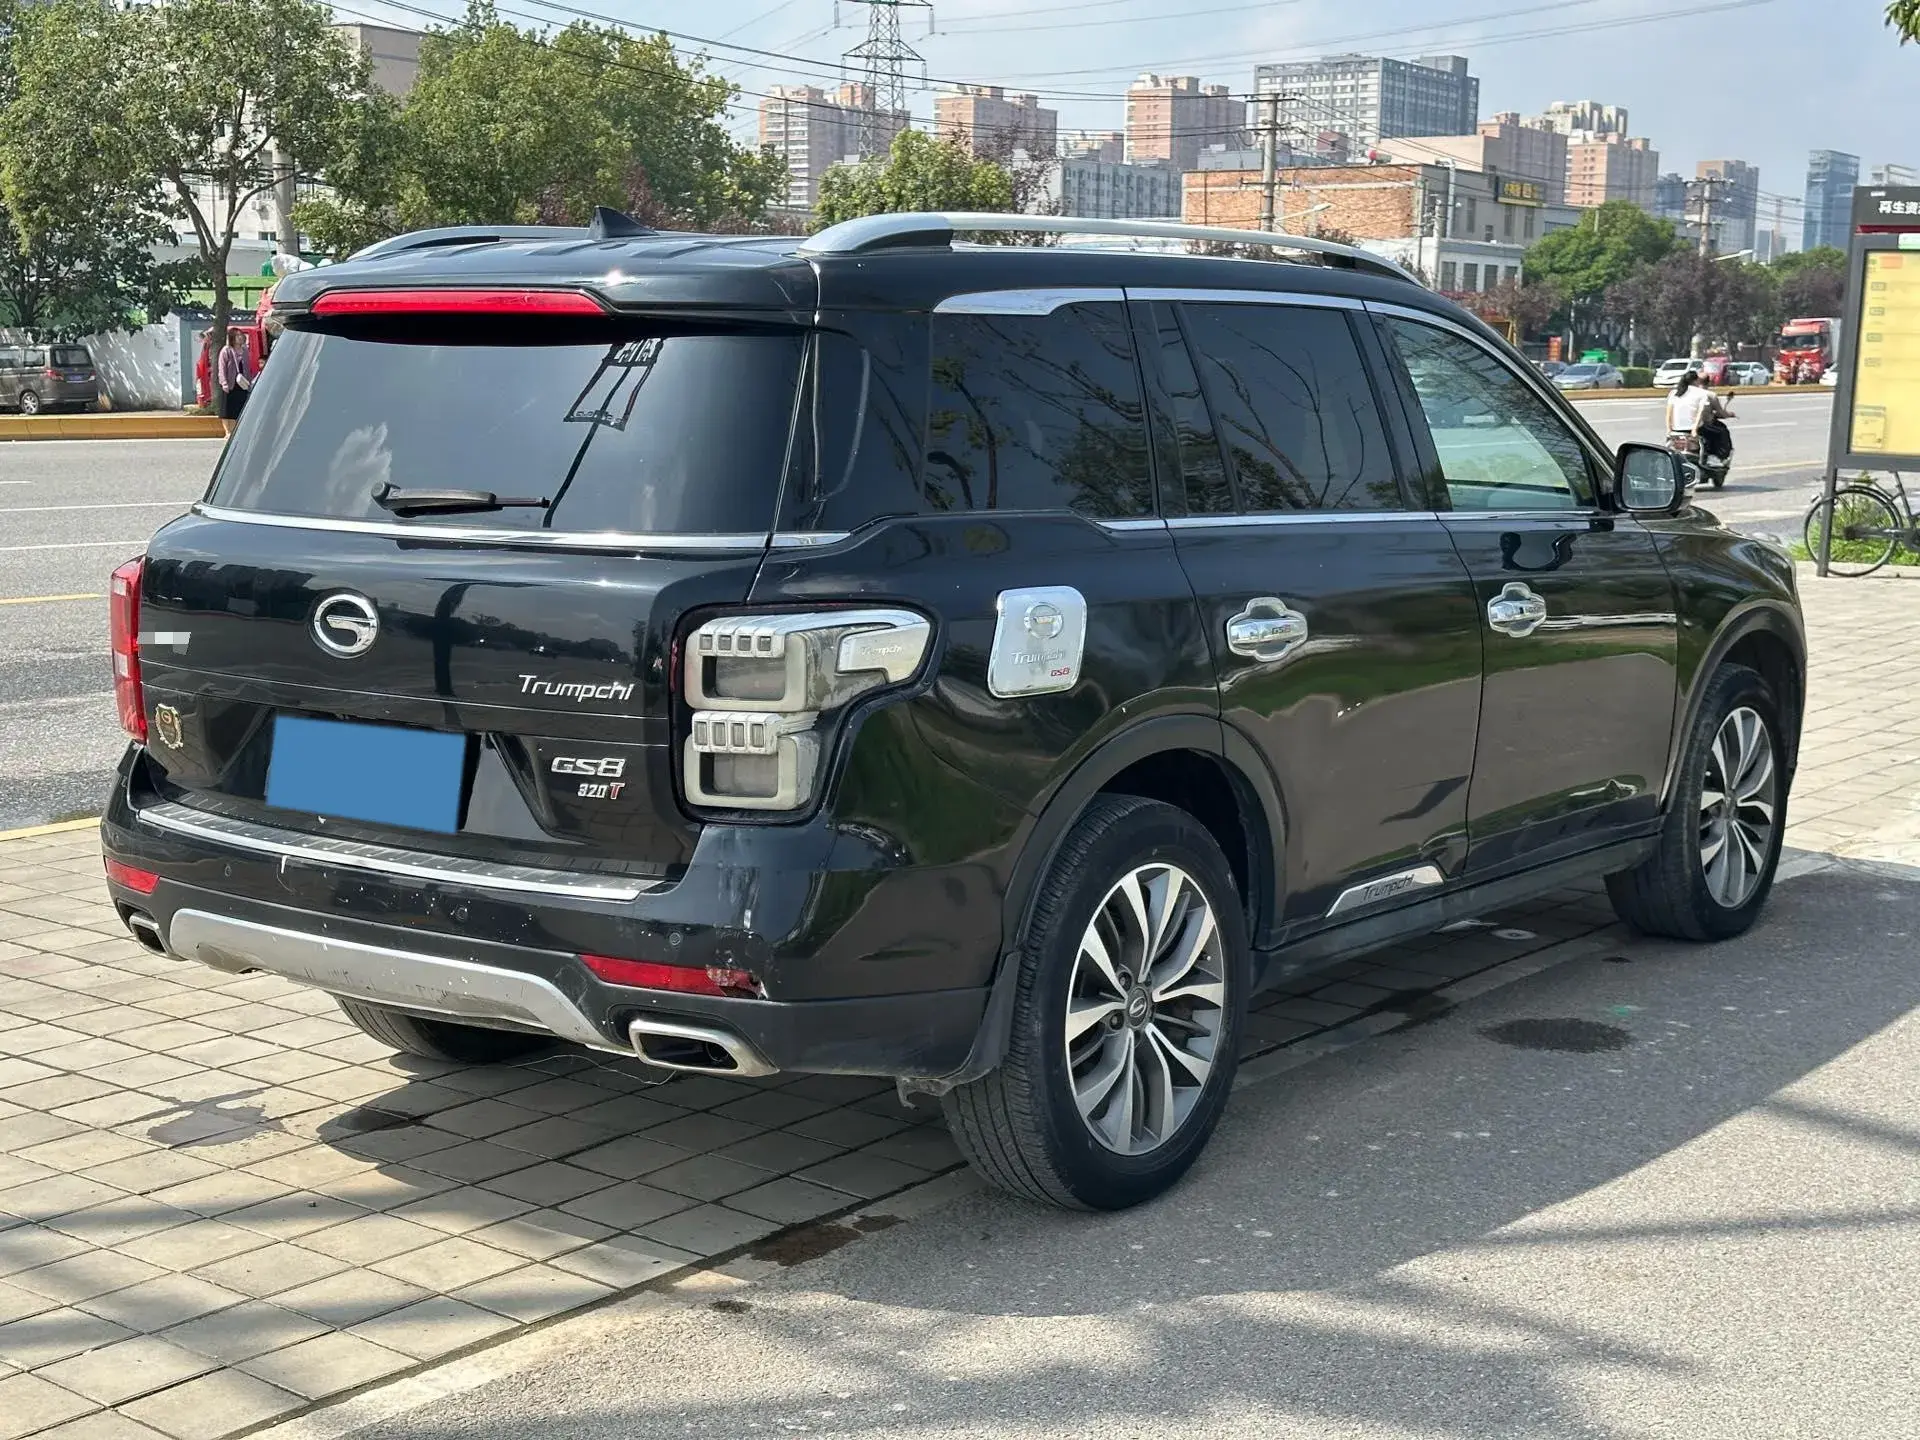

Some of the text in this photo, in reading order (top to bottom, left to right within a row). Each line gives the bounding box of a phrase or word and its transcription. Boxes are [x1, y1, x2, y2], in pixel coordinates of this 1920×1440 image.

[1878, 200, 1920, 215] 再生资
[1050, 667, 1071, 677] GS8
[519, 674, 635, 702] Trumpchi
[551, 756, 626, 778] GS8
